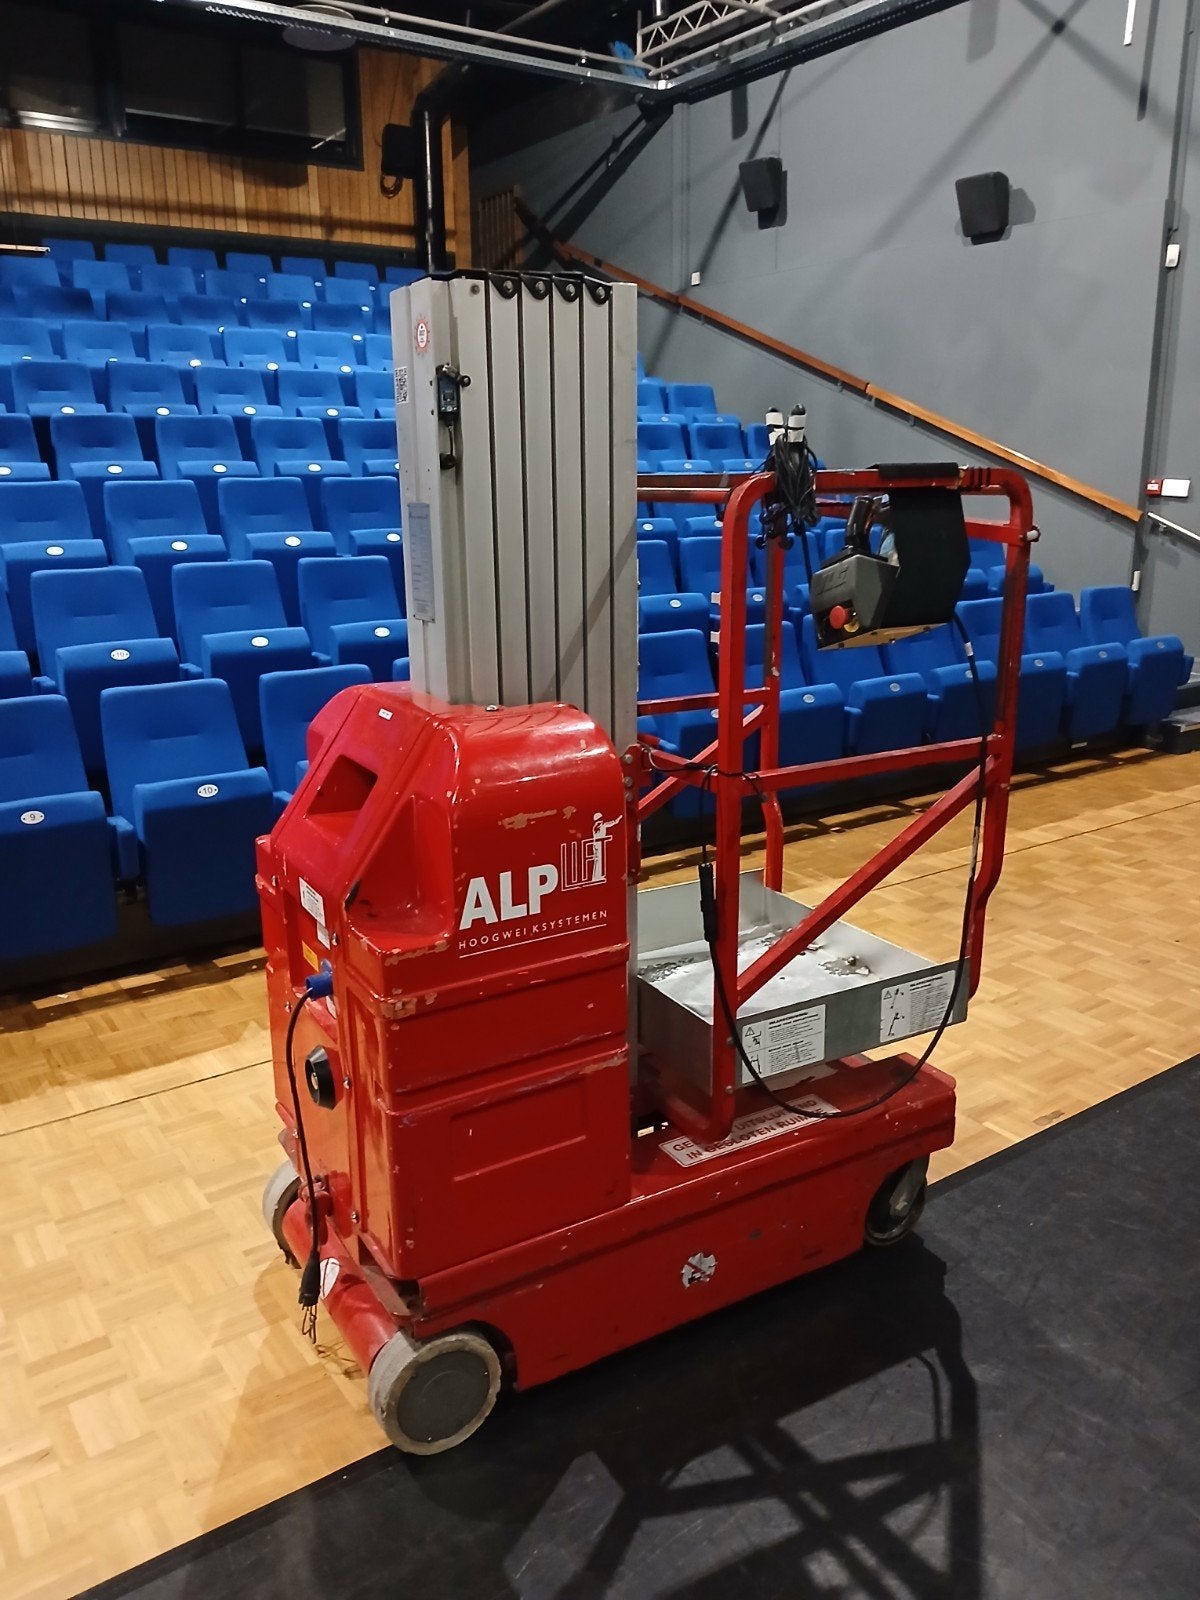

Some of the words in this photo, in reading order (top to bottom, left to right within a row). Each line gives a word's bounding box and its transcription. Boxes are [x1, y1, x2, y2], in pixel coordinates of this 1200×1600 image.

[202, 786, 213, 795] 10
[29, 813, 36, 821] 9
[686, 1149, 704, 1160] IN
